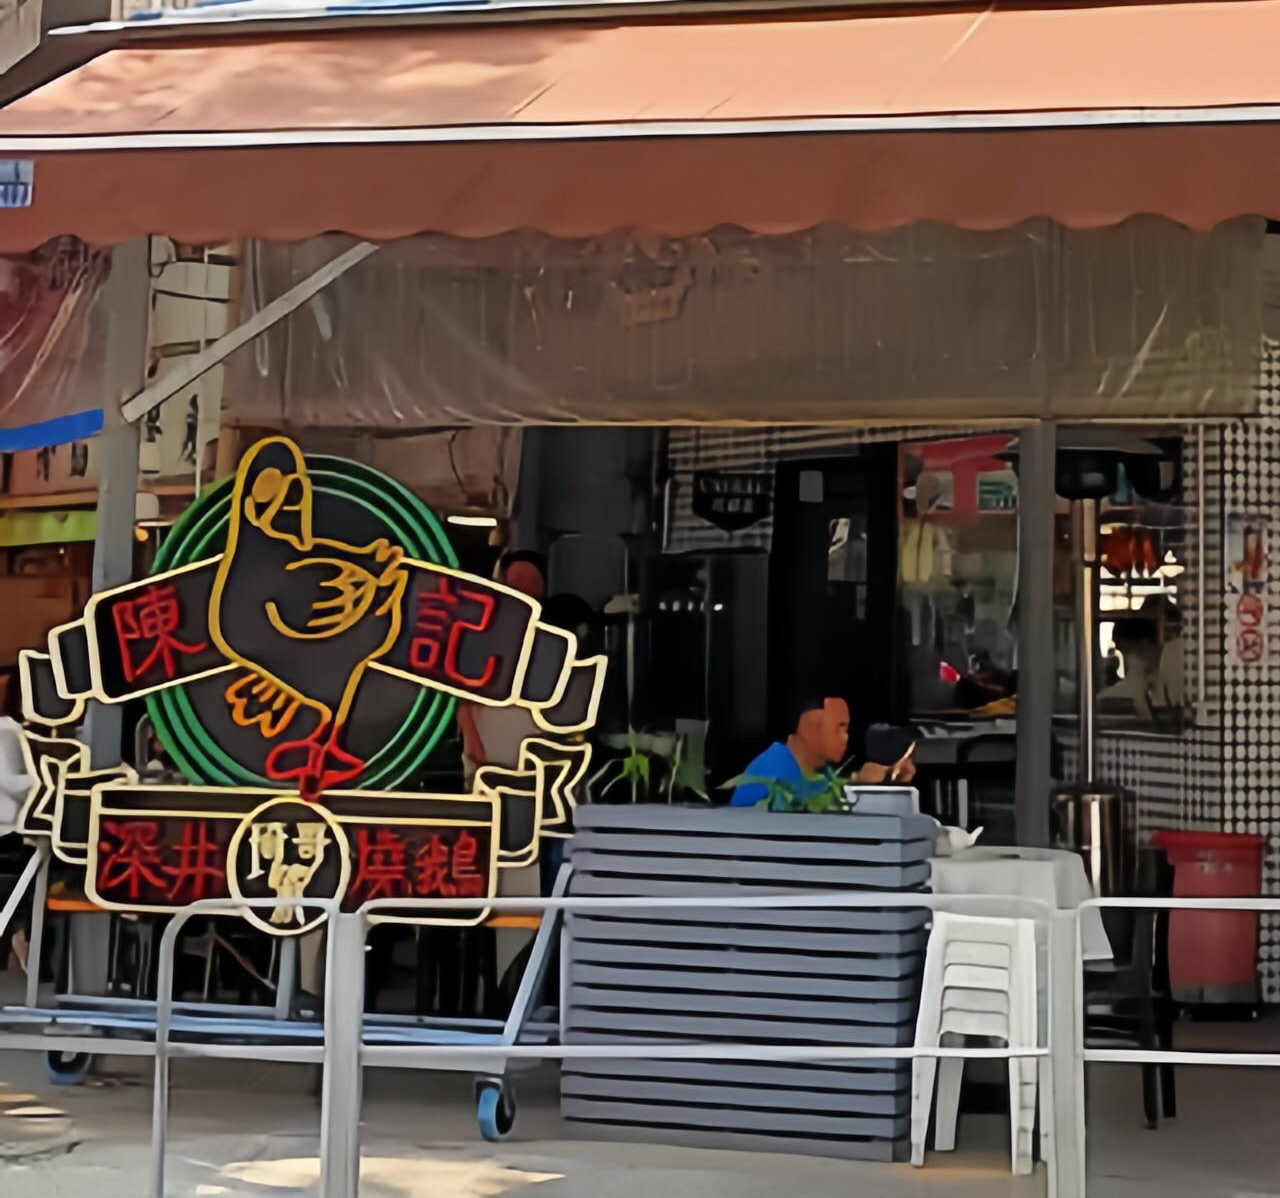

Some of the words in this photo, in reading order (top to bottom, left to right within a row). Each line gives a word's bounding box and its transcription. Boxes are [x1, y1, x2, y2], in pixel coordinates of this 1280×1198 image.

[110, 582, 207, 683] 陳
[409, 576, 498, 688] 記
[99, 820, 224, 900] 深井
